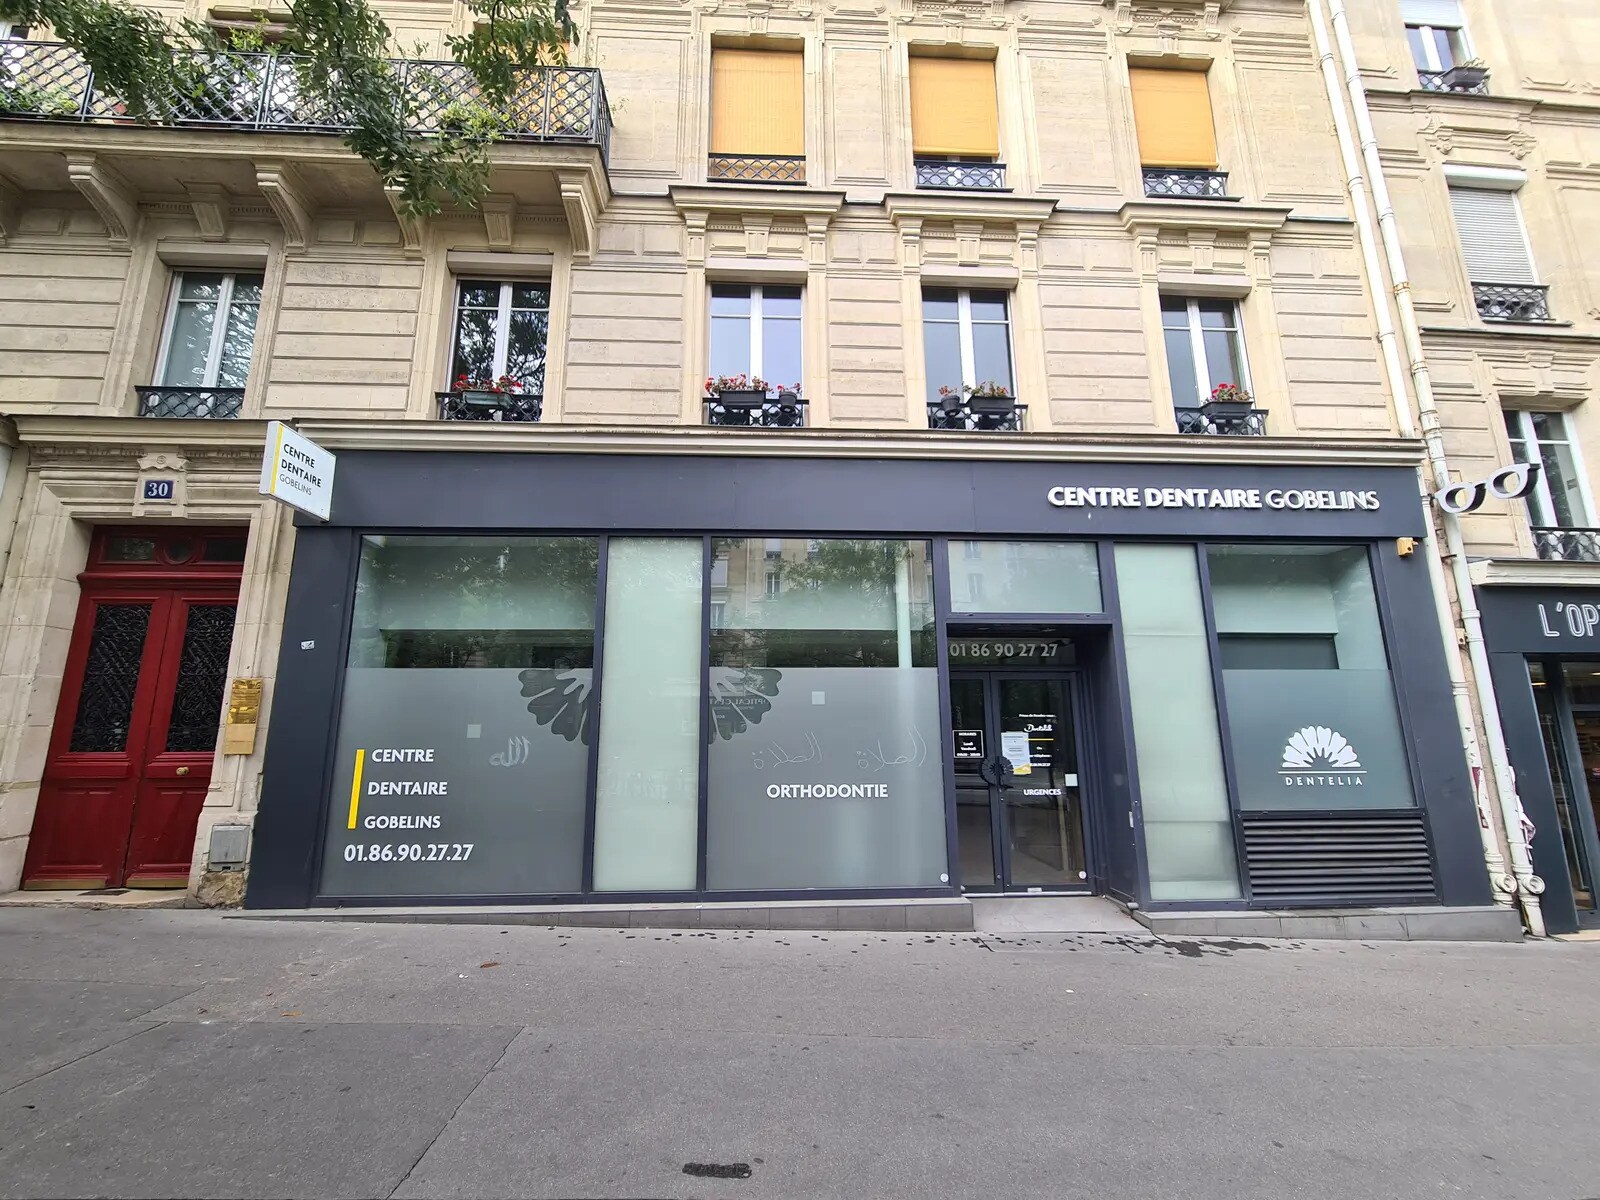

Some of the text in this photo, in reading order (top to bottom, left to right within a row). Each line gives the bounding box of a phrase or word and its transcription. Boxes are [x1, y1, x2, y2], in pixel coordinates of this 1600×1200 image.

[284, 444, 315, 468] CENTRE
[281, 459, 321, 487] DENTAIRE
[148, 482, 169, 497] 30
[280, 474, 311, 495] GOBELINS
[1048, 486, 1381, 511] CENTRE DENTAIRE GOBELINS
[1538, 601, 1600, 637] L'OP
[949, 643, 1058, 657] 01 86 90 27 27
[371, 749, 435, 762] CENTRE
[367, 781, 448, 795] DENTAIRE
[1285, 776, 1363, 786] DENTELIA
[766, 783, 889, 799] ORTHODONTIE
[1023, 788, 1062, 796] URGENCES
[364, 815, 441, 829] GOBELINS
[343, 843, 474, 862] 01.86.90.27.27
